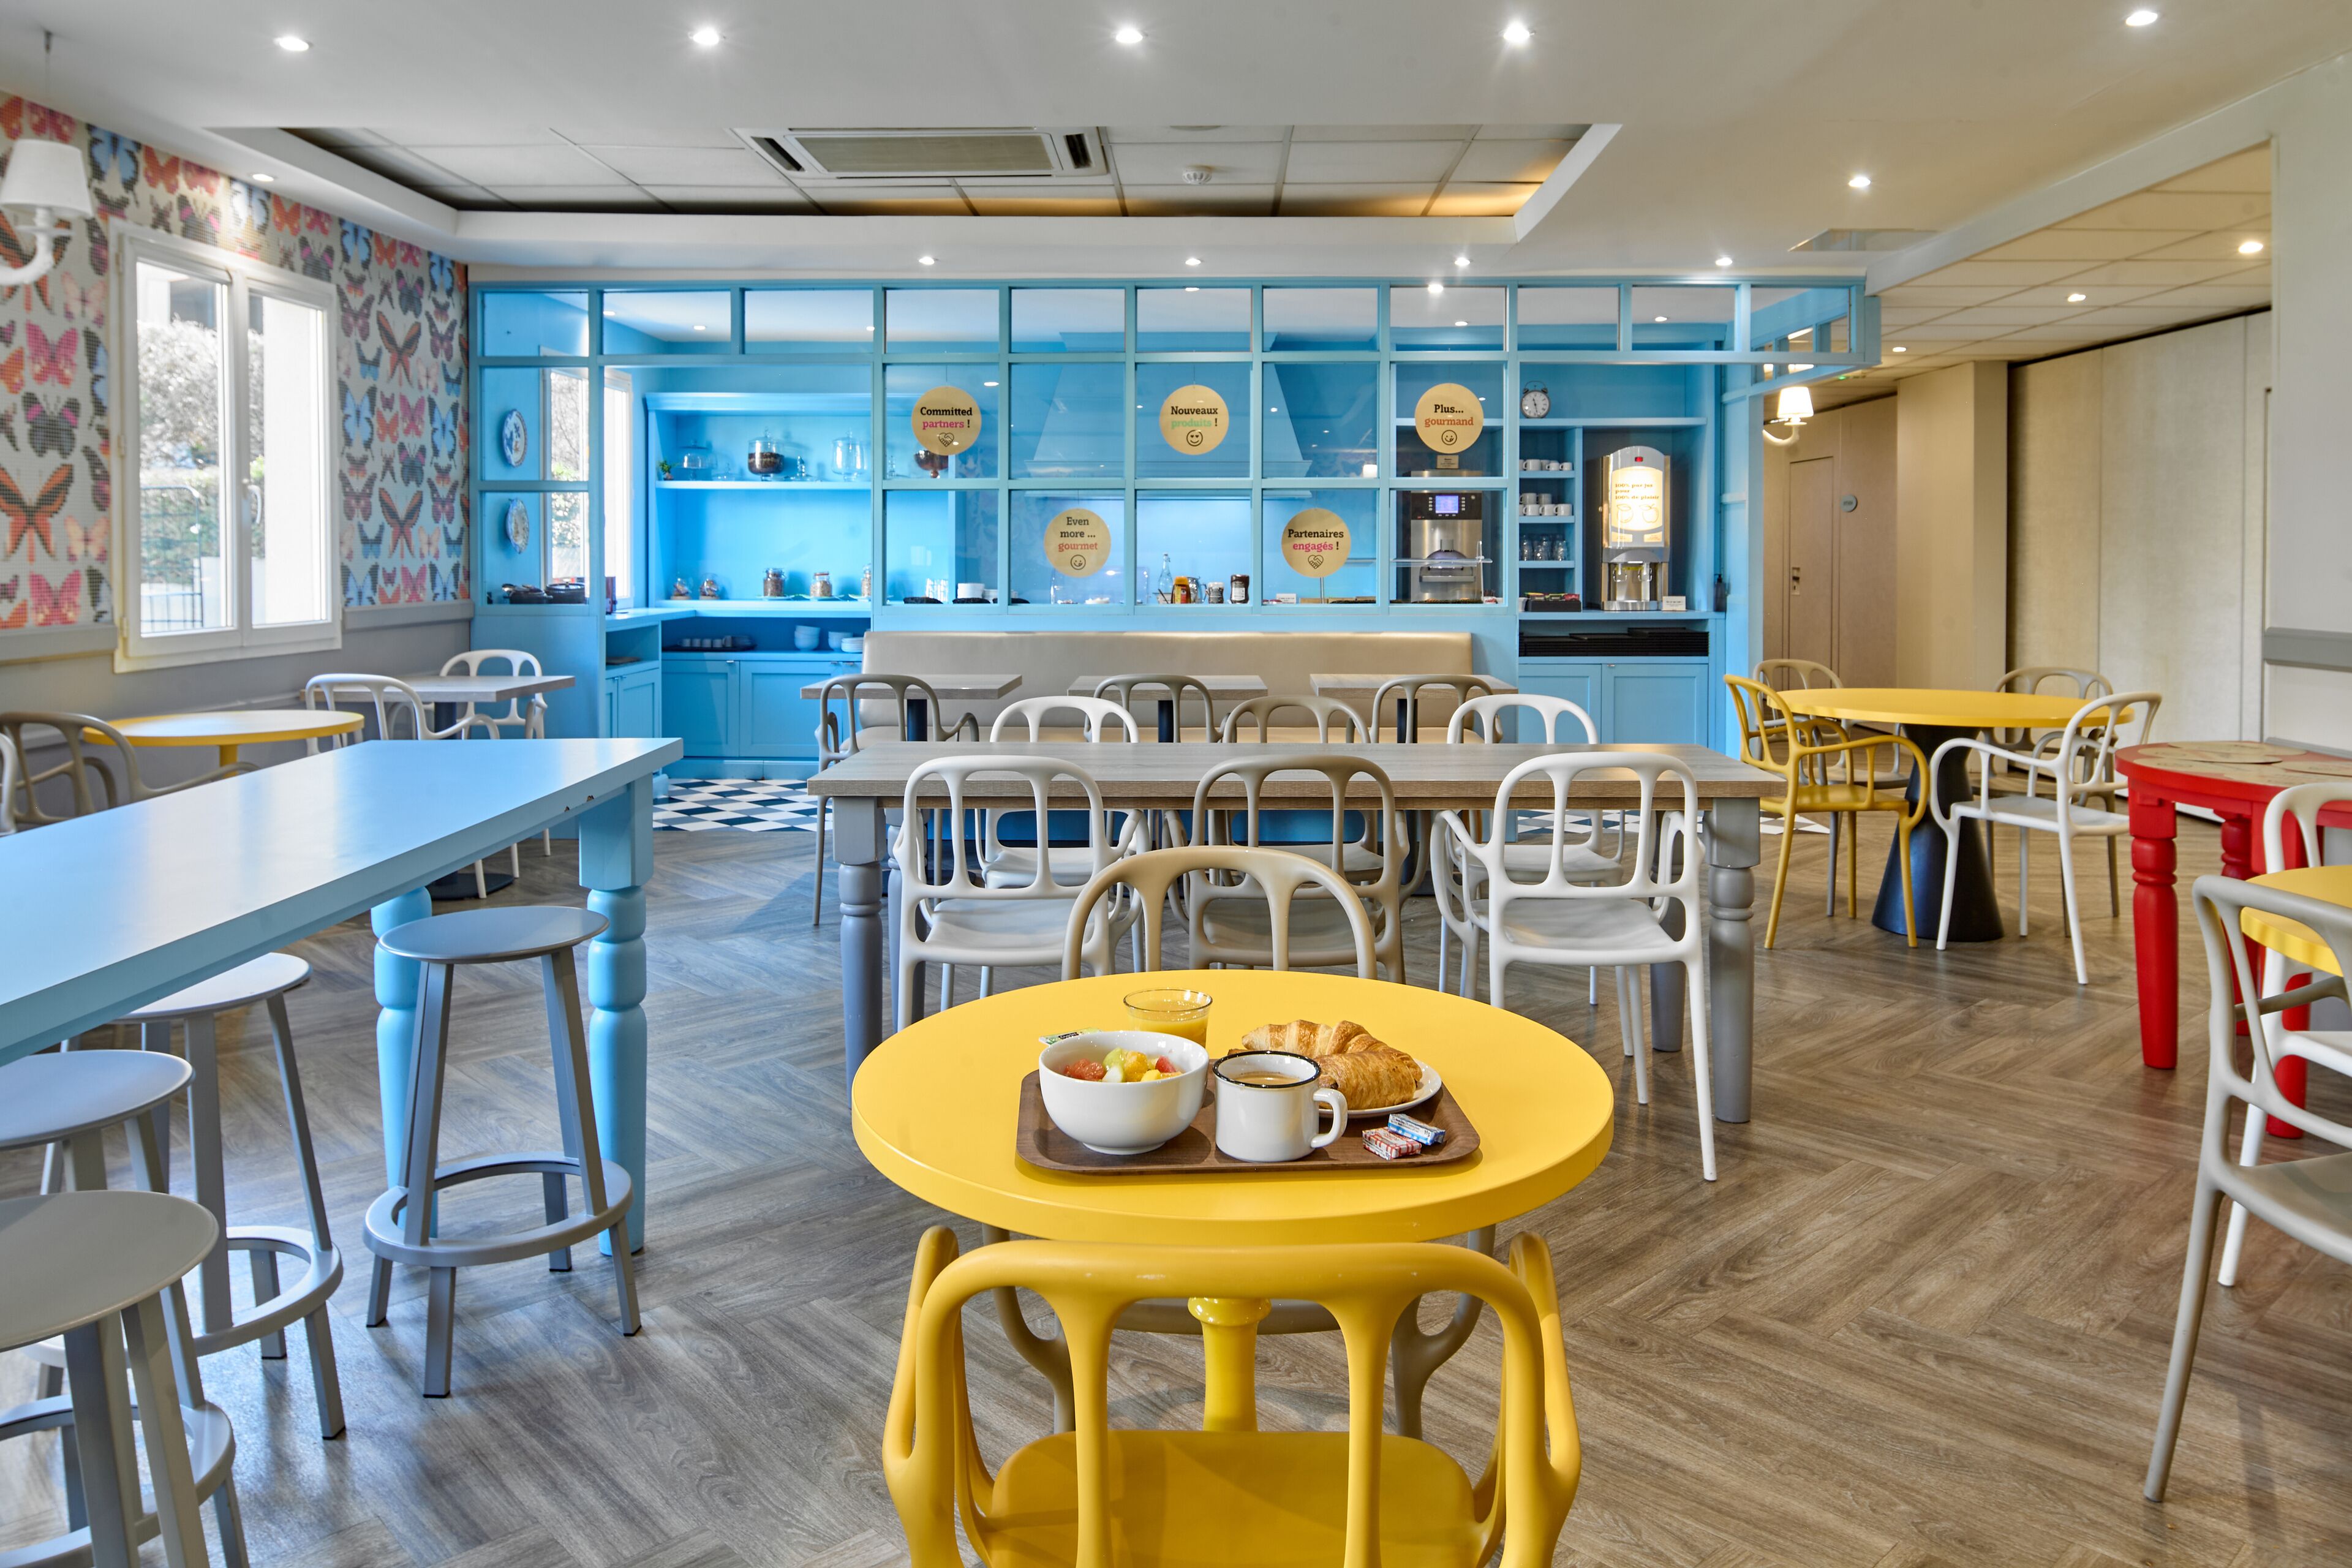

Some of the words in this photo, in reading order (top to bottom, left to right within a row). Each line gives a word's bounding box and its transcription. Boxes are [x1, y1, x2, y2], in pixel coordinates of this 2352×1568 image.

[920, 407, 973, 416] Committed
[1171, 406, 1218, 415] Nouveaux
[1434, 404, 1464, 413] Plus...
[922, 420, 964, 430] partners
[967, 419, 970, 428] !
[1171, 418, 1212, 429] produits
[1215, 418, 1218, 427] !
[1425, 417, 1474, 428] gourmand
[1066, 516, 1089, 526] Even
[1287, 529, 1344, 538] Partenaires
[1058, 543, 1098, 552] gourmet
[1293, 541, 1333, 552] engagés
[1336, 541, 1340, 551] !
